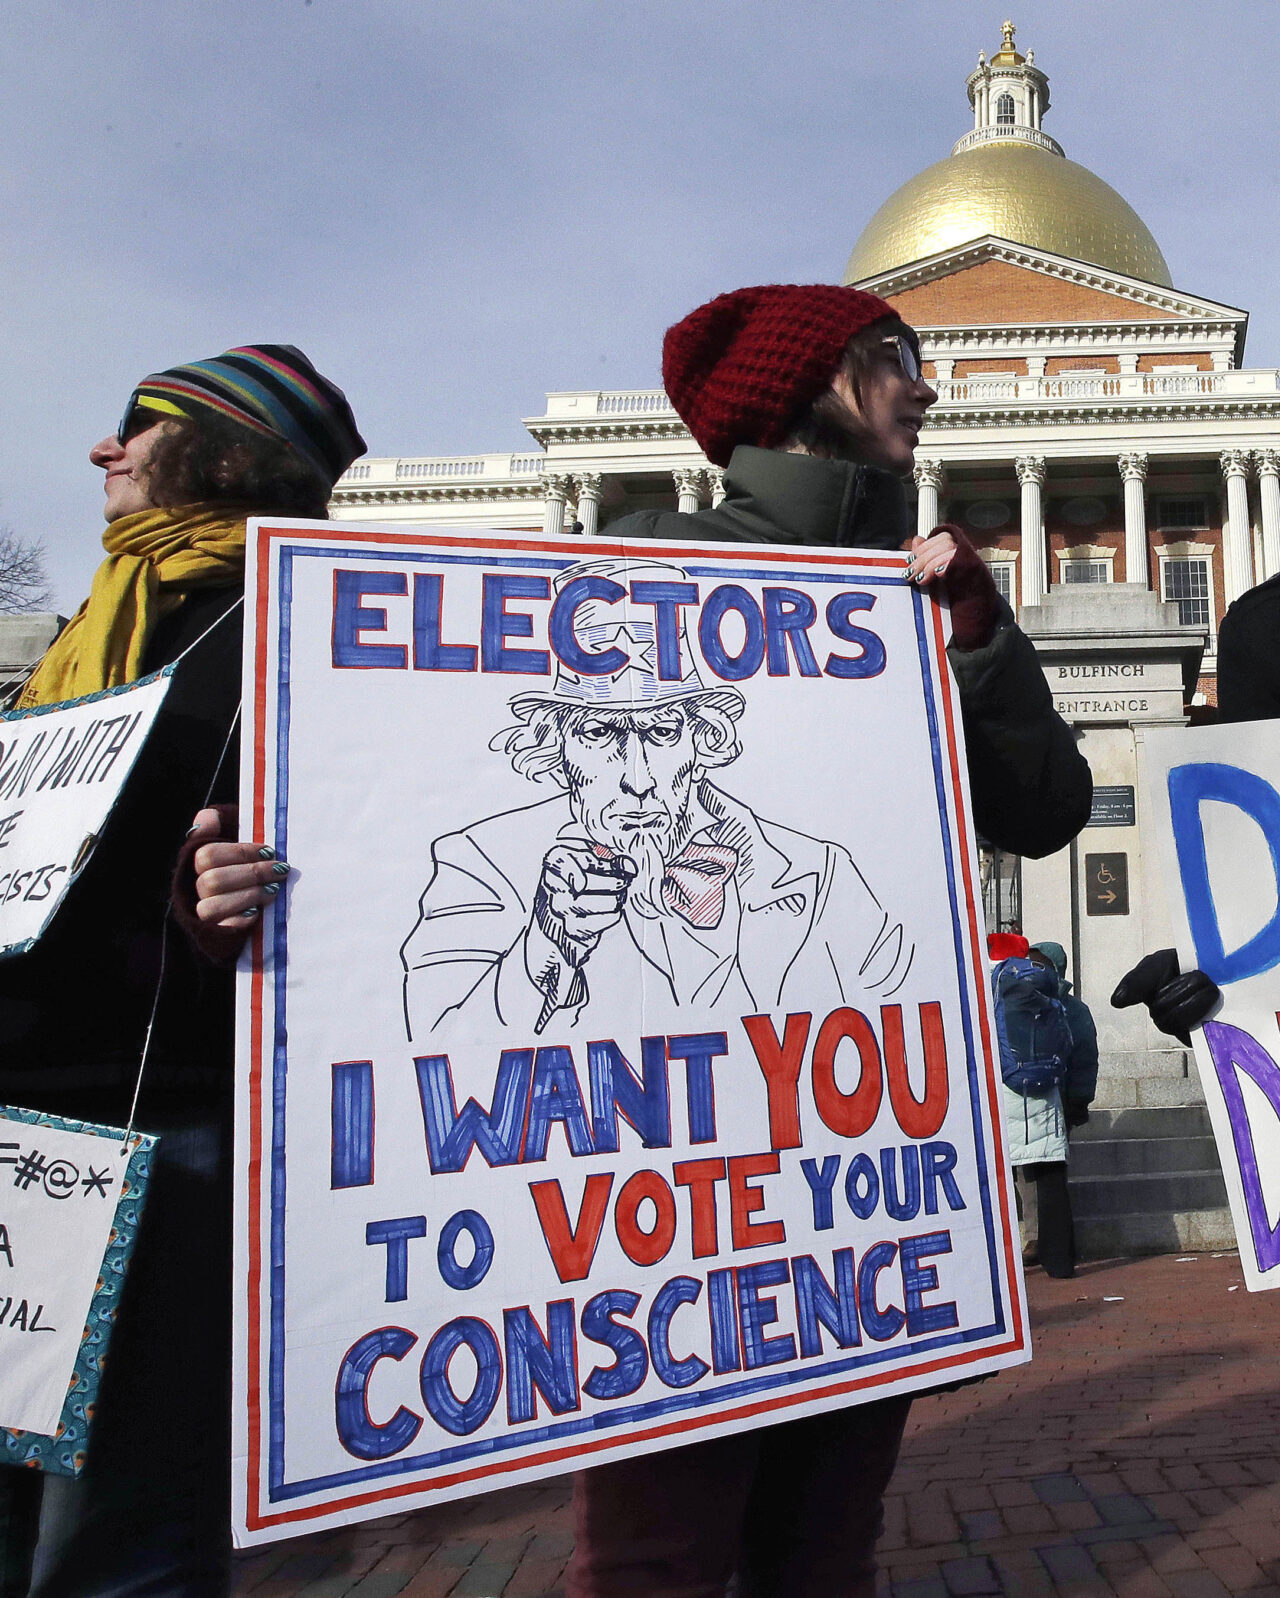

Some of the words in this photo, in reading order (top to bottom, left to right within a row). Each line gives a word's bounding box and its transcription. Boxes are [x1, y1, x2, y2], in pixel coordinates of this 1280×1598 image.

[331, 568, 888, 682] ELECTORS
[1058, 665, 1144, 678] BULFINCH
[36, 710, 143, 792] WITH
[1057, 700, 1149, 713] ENTRANCE
[330, 1060, 374, 1190] I
[413, 1032, 728, 1175] WANT
[741, 1001, 949, 1151] YOU
[365, 1208, 494, 1303] TO
[528, 1151, 787, 1284] VOTE
[801, 1141, 967, 1231] YOUR
[335, 1230, 960, 1461] CONSCIENCE
